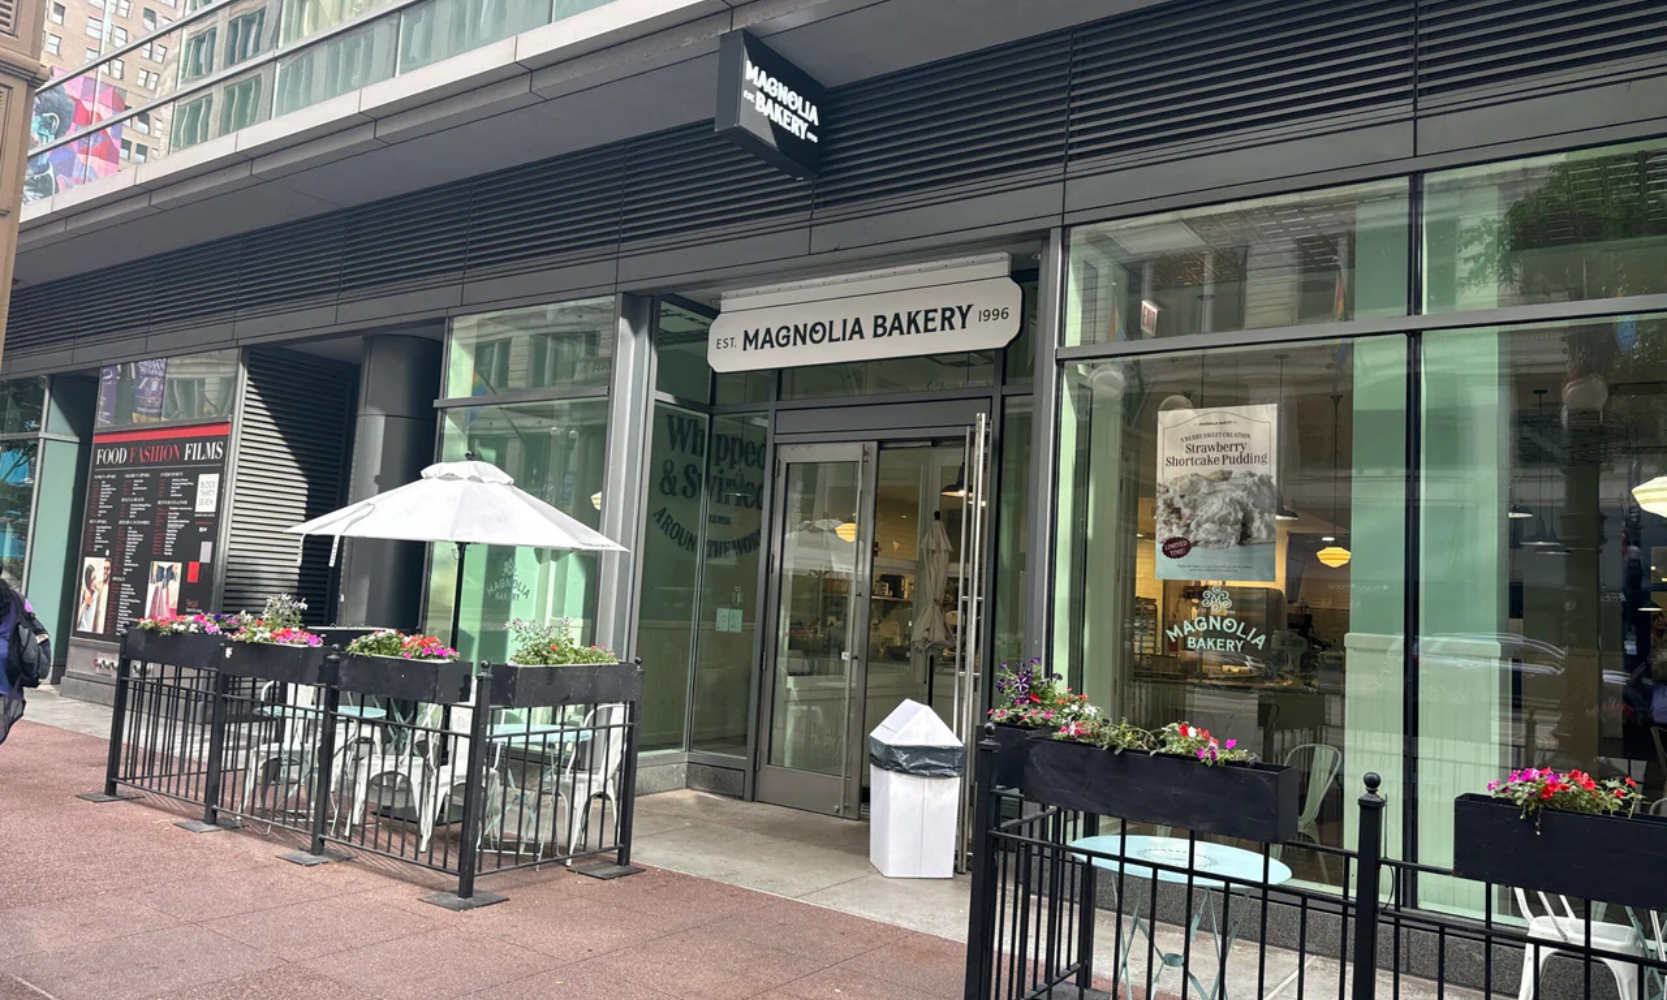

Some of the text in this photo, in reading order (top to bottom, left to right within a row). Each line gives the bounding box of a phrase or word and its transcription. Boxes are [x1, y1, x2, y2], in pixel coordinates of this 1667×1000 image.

[745, 60, 819, 126] MAGNOLIA
[755, 91, 809, 140] BAKERY
[716, 304, 1010, 352] EST. MAGNOLIA BAKERY 1996
[96, 441, 223, 465] FOOD FASHION FILMS
[666, 414, 766, 471] Whppe
[1184, 441, 1247, 454] Strawberry
[1203, 431, 1223, 440] SWEET
[1165, 452, 1267, 467] Shortcake Pudding
[659, 459, 764, 511] & Sirle
[653, 506, 698, 555] AROUN
[706, 540, 732, 558] THE
[732, 528, 761, 556] WOR
[486, 578, 530, 599] MAGNOLIA
[1165, 615, 1267, 651] MAGNOLIA
[1187, 636, 1244, 652] BAKERY
